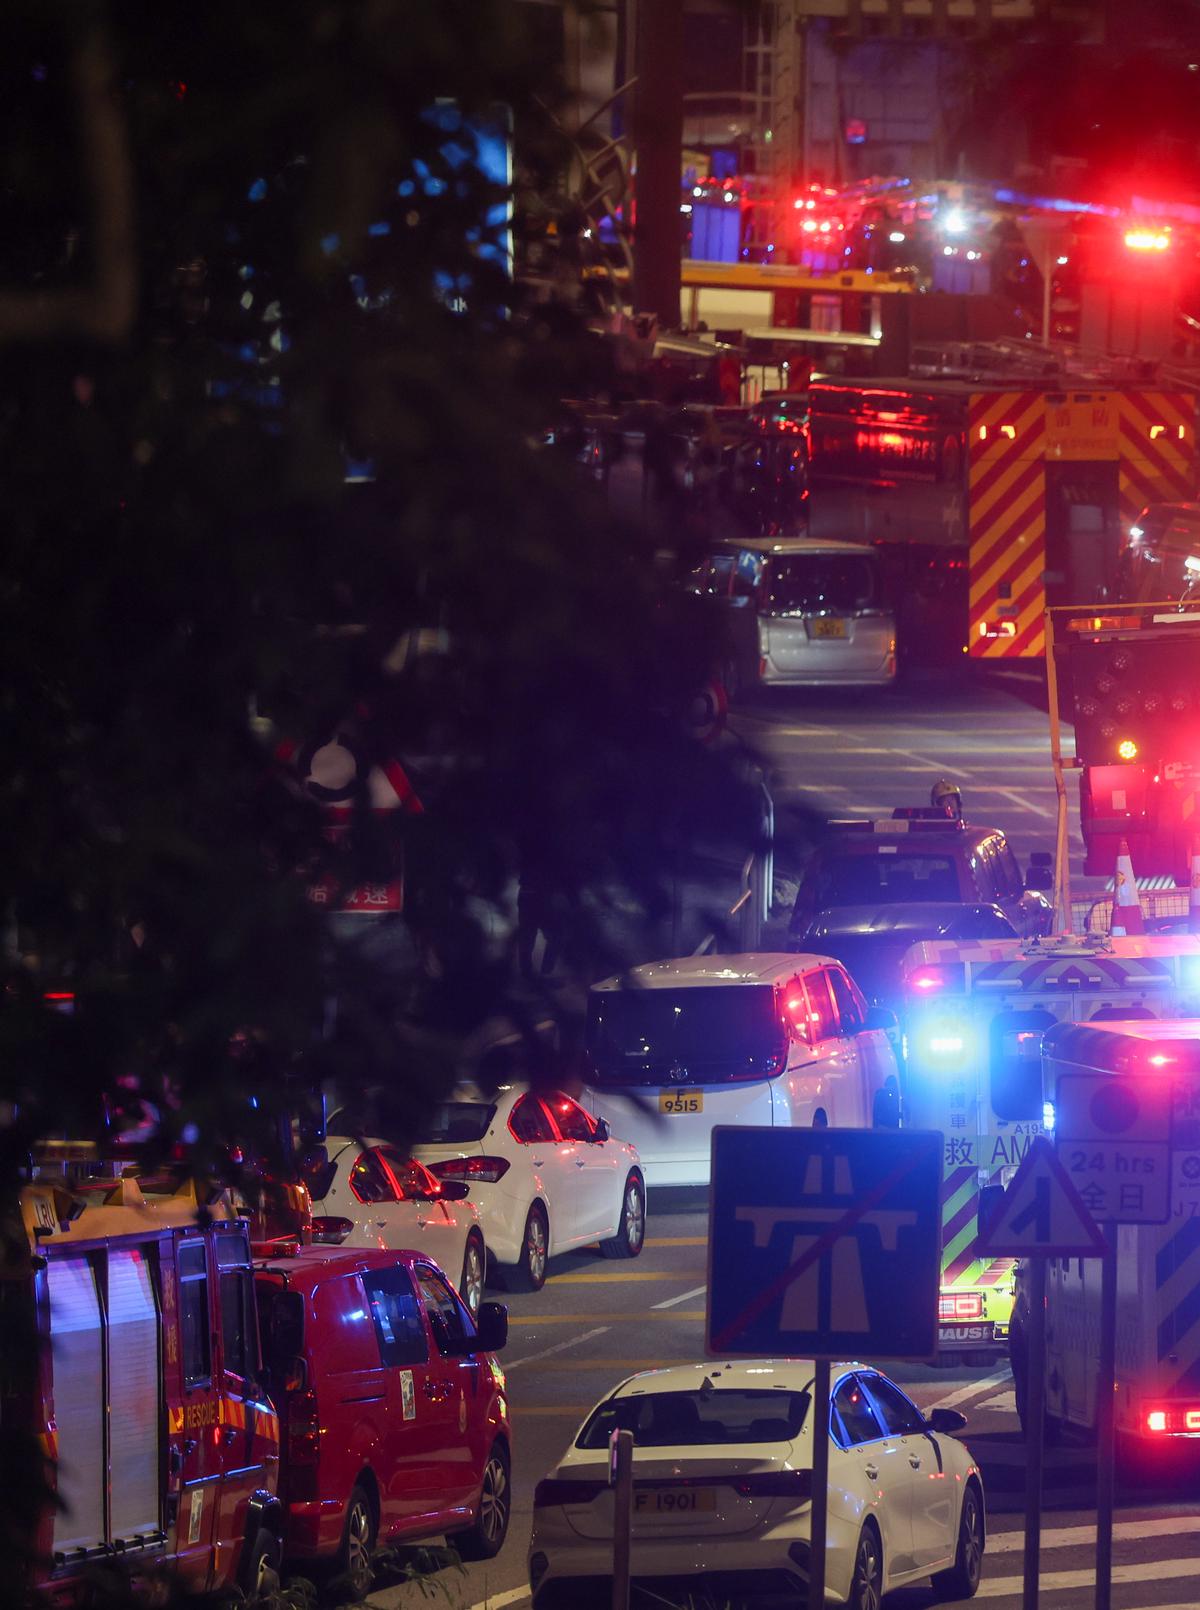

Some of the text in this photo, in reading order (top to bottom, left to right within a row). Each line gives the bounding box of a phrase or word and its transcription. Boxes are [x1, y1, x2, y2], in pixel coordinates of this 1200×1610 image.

[676, 1089, 686, 1101] F
[664, 1100, 698, 1112] 9515
[945, 1137, 974, 1166] 救
[1071, 1151, 1156, 1174] 24 hrs
[1080, 1181, 1144, 1213] 全日
[635, 1493, 697, 1512] F 1901
